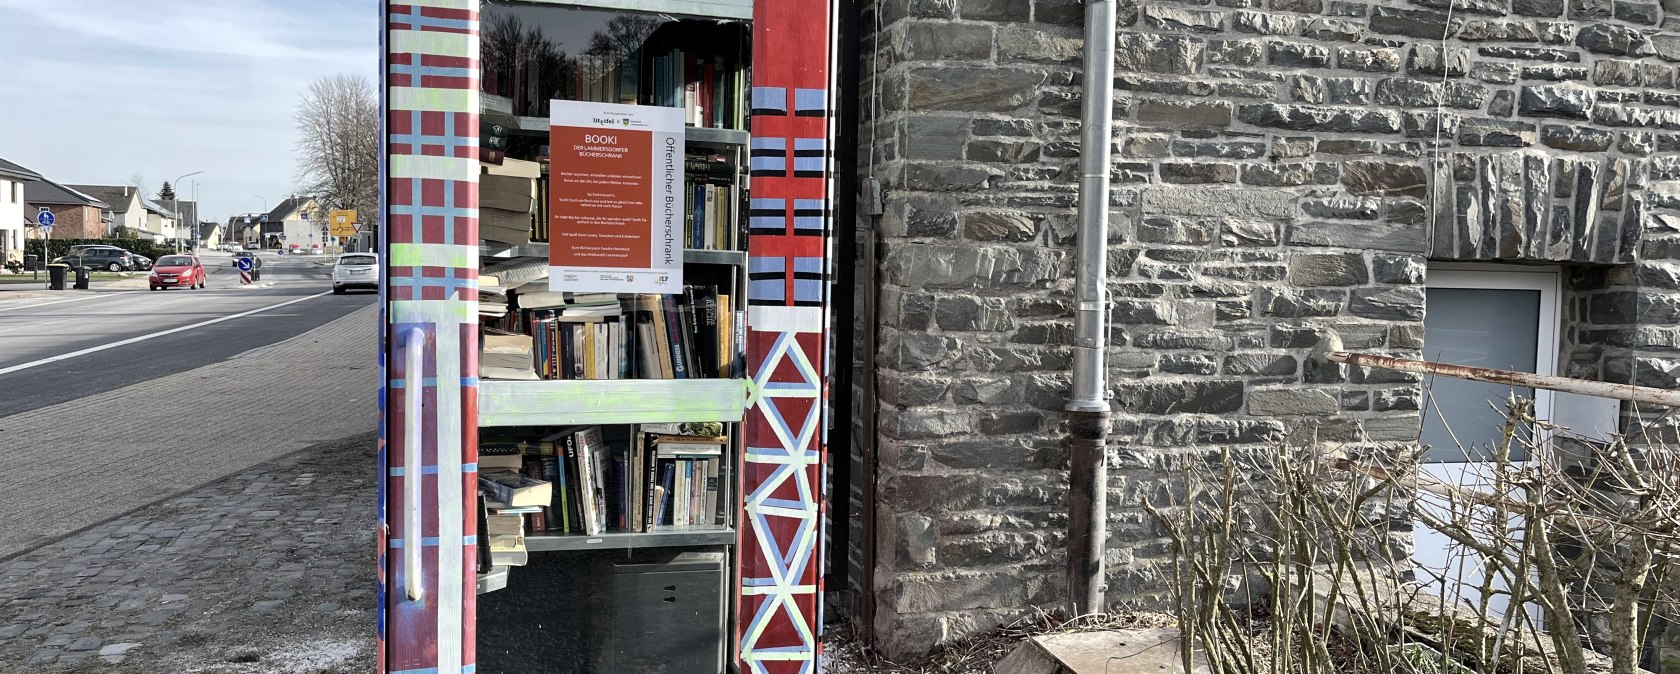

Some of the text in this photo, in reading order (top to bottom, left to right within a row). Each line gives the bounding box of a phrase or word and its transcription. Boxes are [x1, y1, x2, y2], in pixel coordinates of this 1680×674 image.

[585, 134, 617, 145] BOOKI
[579, 151, 623, 159] BÜCHERSCHRANK
[664, 137, 677, 265] Öffentlicher Bücherschrank
